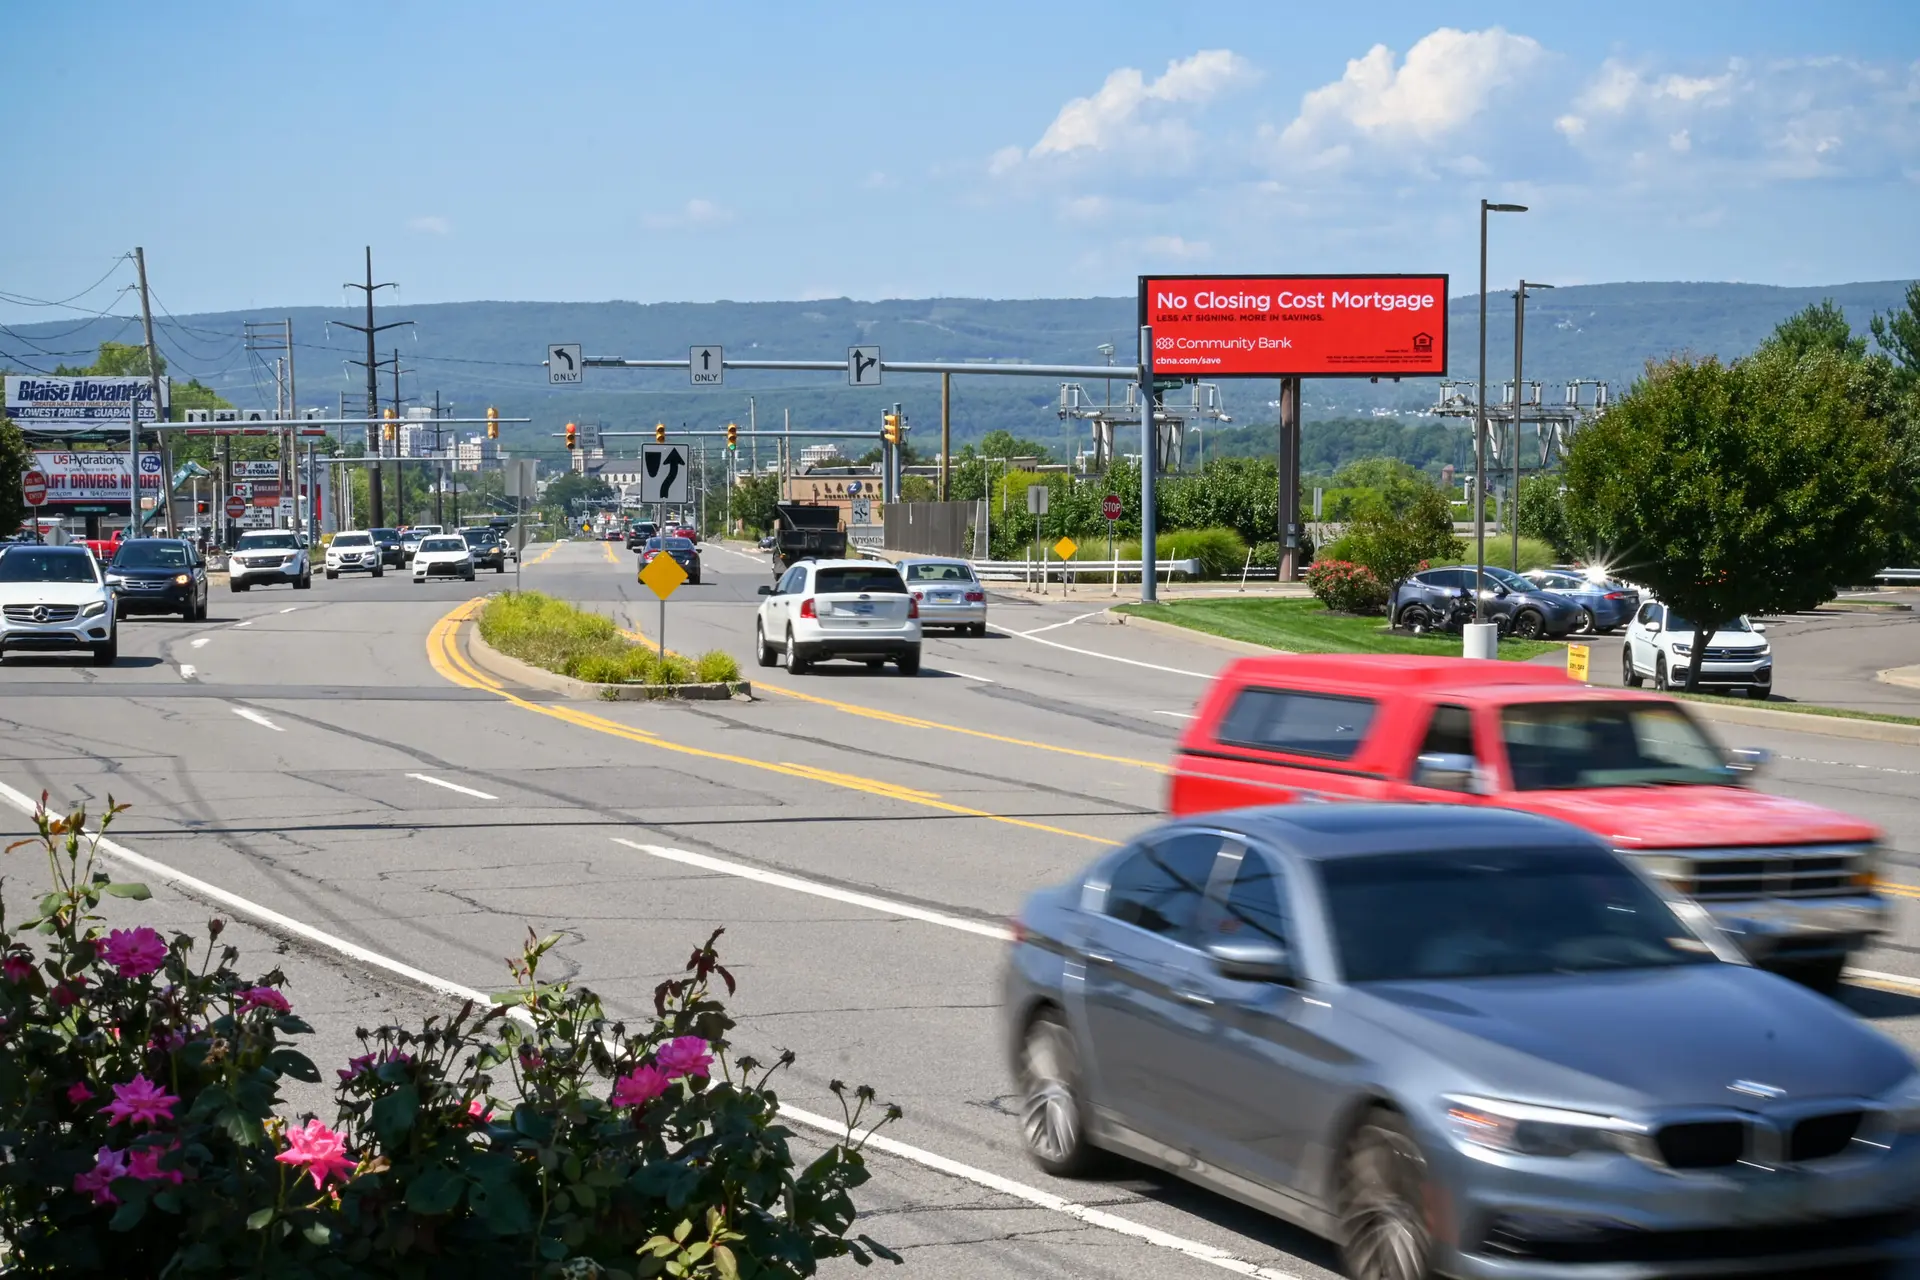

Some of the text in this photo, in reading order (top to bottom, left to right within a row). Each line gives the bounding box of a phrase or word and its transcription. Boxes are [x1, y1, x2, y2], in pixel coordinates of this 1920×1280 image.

[1157, 291, 1435, 312] No Closing Cost Mortgage
[1156, 314, 1179, 322] LESS
[1182, 314, 1193, 322] AT
[1196, 314, 1237, 322] SIGNING.
[1240, 314, 1266, 322] MORE
[1282, 314, 1325, 322] SAVINGS.
[1176, 337, 1292, 351] Community Bank
[1155, 356, 1221, 365] cbna.com/save
[554, 373, 578, 382] ONLY
[694, 373, 718, 382] ONLY
[17, 380, 70, 401] Blaise
[18, 408, 156, 418] LOWEST PRICE GUARANEED
[71, 474, 117, 489] DRIVERS
[121, 474, 161, 489] NDED
[1103, 502, 1121, 512] STOP
